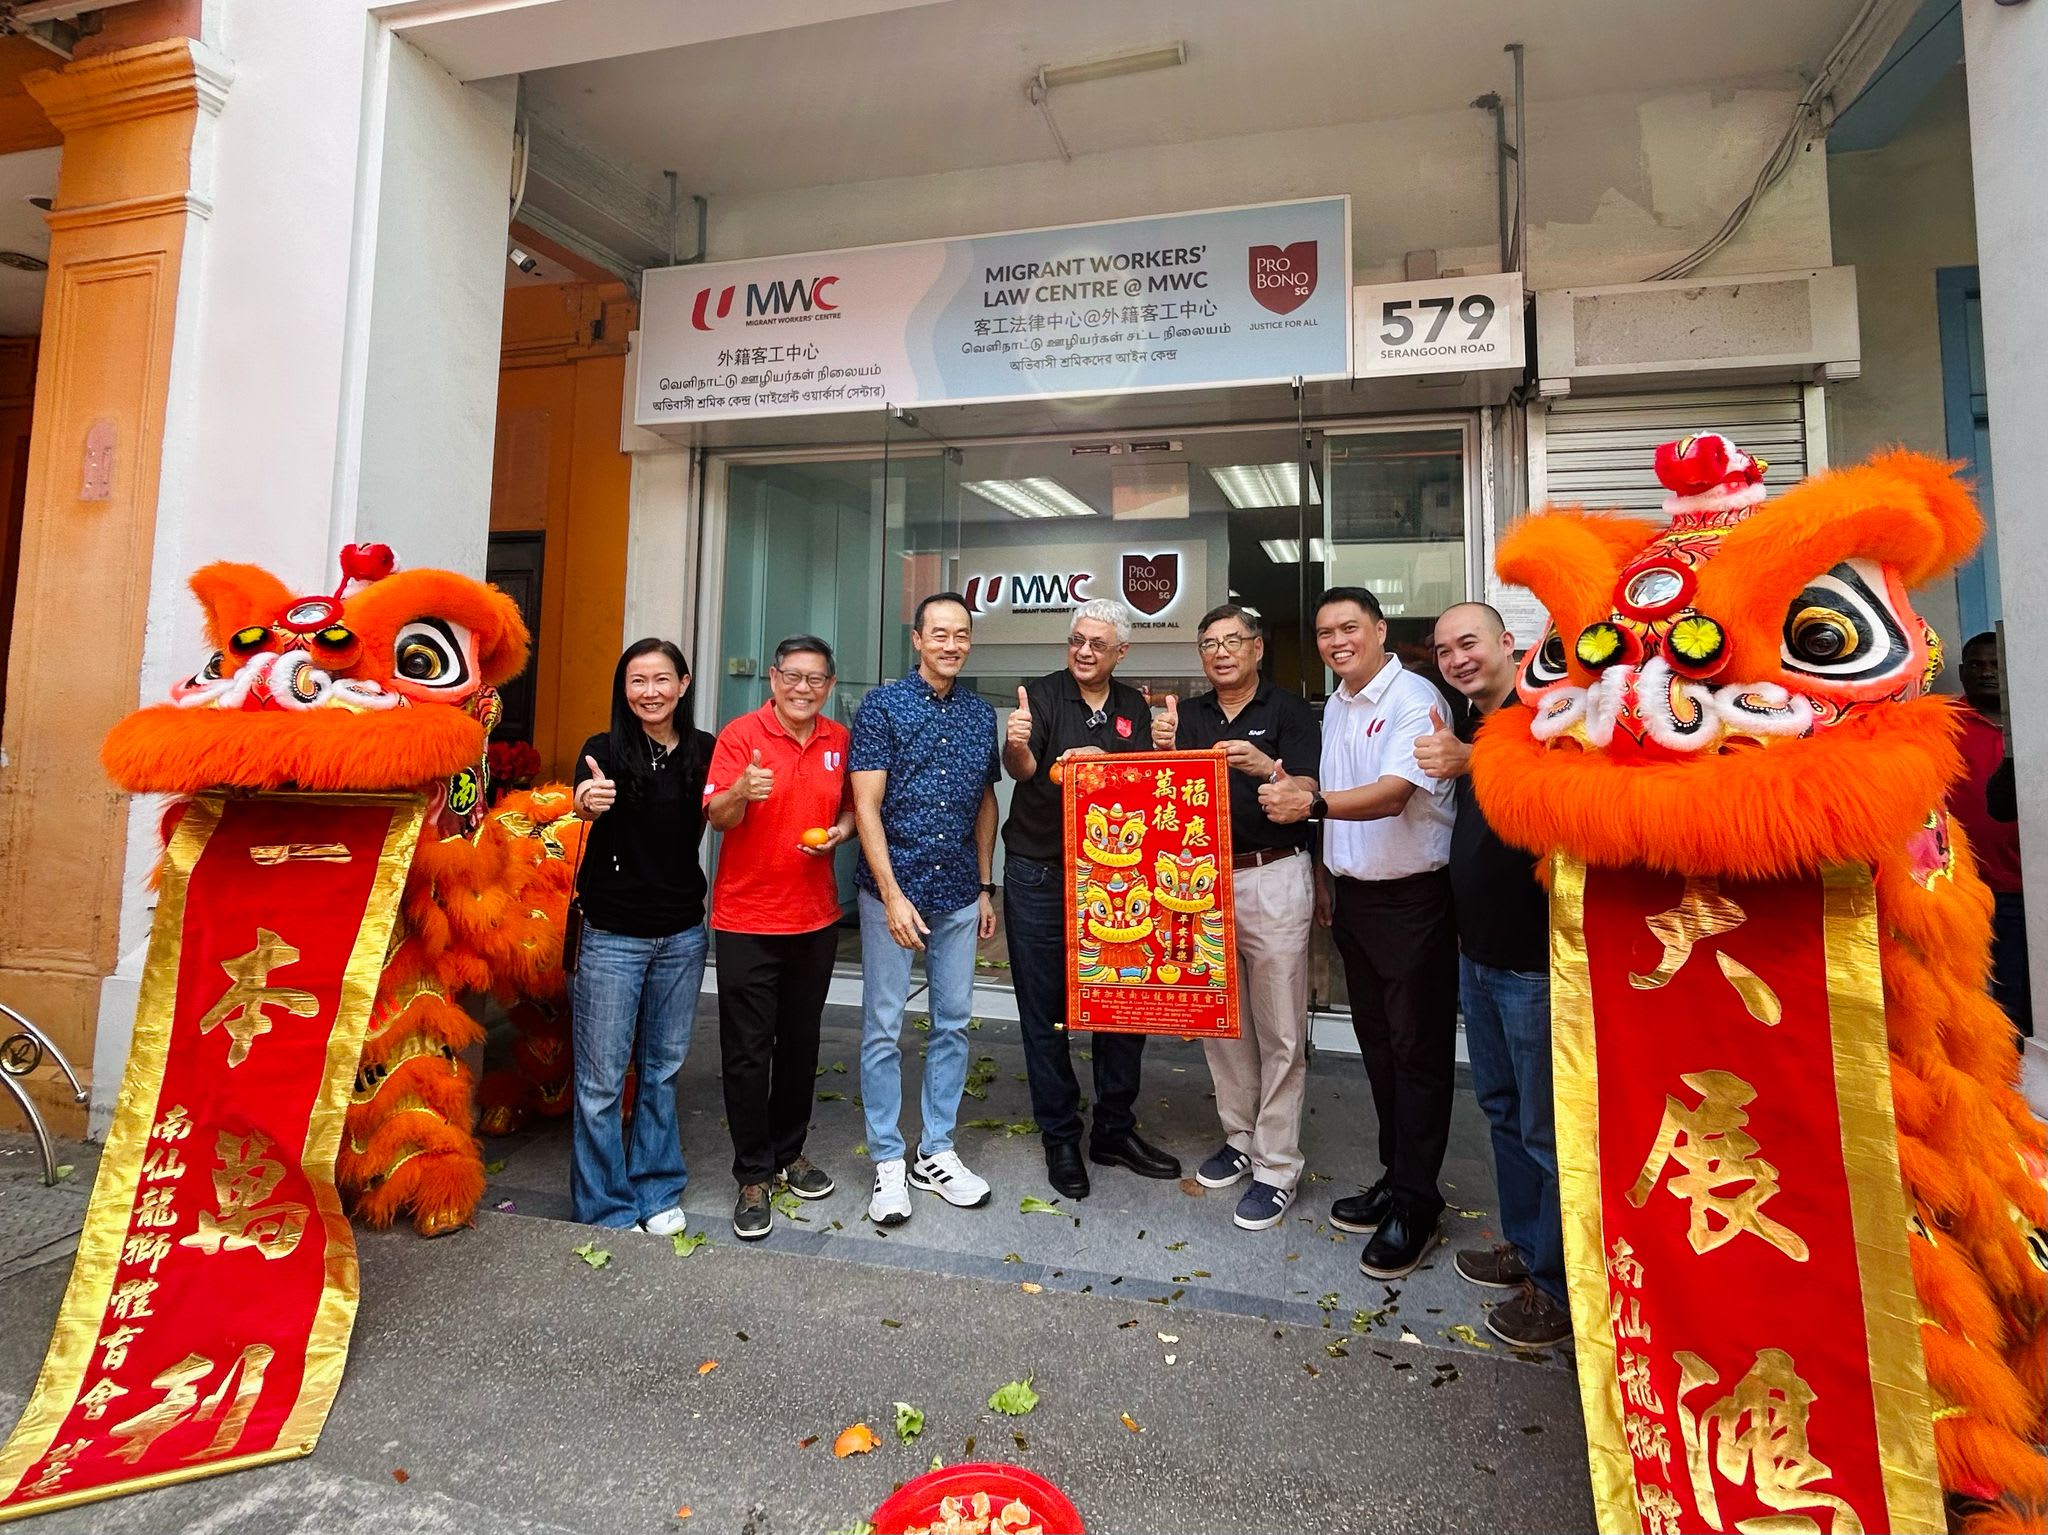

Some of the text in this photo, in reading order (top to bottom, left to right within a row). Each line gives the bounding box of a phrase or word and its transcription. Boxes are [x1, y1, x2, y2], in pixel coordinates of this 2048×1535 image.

[986, 246, 1207, 284] MIGRANT WORKERS'
[1256, 257, 1291, 273] PRO
[982, 270, 1209, 309] LAW CENTRE @ MWC
[1256, 271, 1310, 289] BONO
[1294, 286, 1310, 296] SG
[746, 275, 841, 317] MWC
[745, 312, 842, 327] MIGRANT WORKERS' CENTRE
[973, 298, 1219, 337] 客工法律中心@外籍客工中心
[1249, 319, 1319, 331] JUSTICE FOR ALL
[1379, 294, 1496, 346] 579
[961, 337, 1044, 355] வெளிநாட்டு
[1126, 328, 1161, 343] சட்ட
[1163, 321, 1232, 341] நிலையம்
[717, 342, 820, 368] 外籍客工中心
[1008, 353, 1057, 372] অভিবাসী
[1116, 349, 1148, 365] আইন
[1150, 348, 1178, 363] কেন্দ্র
[1380, 342, 1496, 360] SERANGOON ROAD
[659, 373, 738, 392] வெளிநாட்டு
[816, 362, 882, 382] நிலையம்
[652, 394, 694, 412] অভিবাসী
[696, 392, 726, 410] শ্রমিক
[727, 393, 752, 408] কেন্দ্র
[1128, 565, 1156, 579] PRO
[1011, 573, 1093, 604] MWC
[1128, 578, 1171, 593] BONO
[1158, 592, 1171, 600] SG
[452, 772, 477, 809] 南
